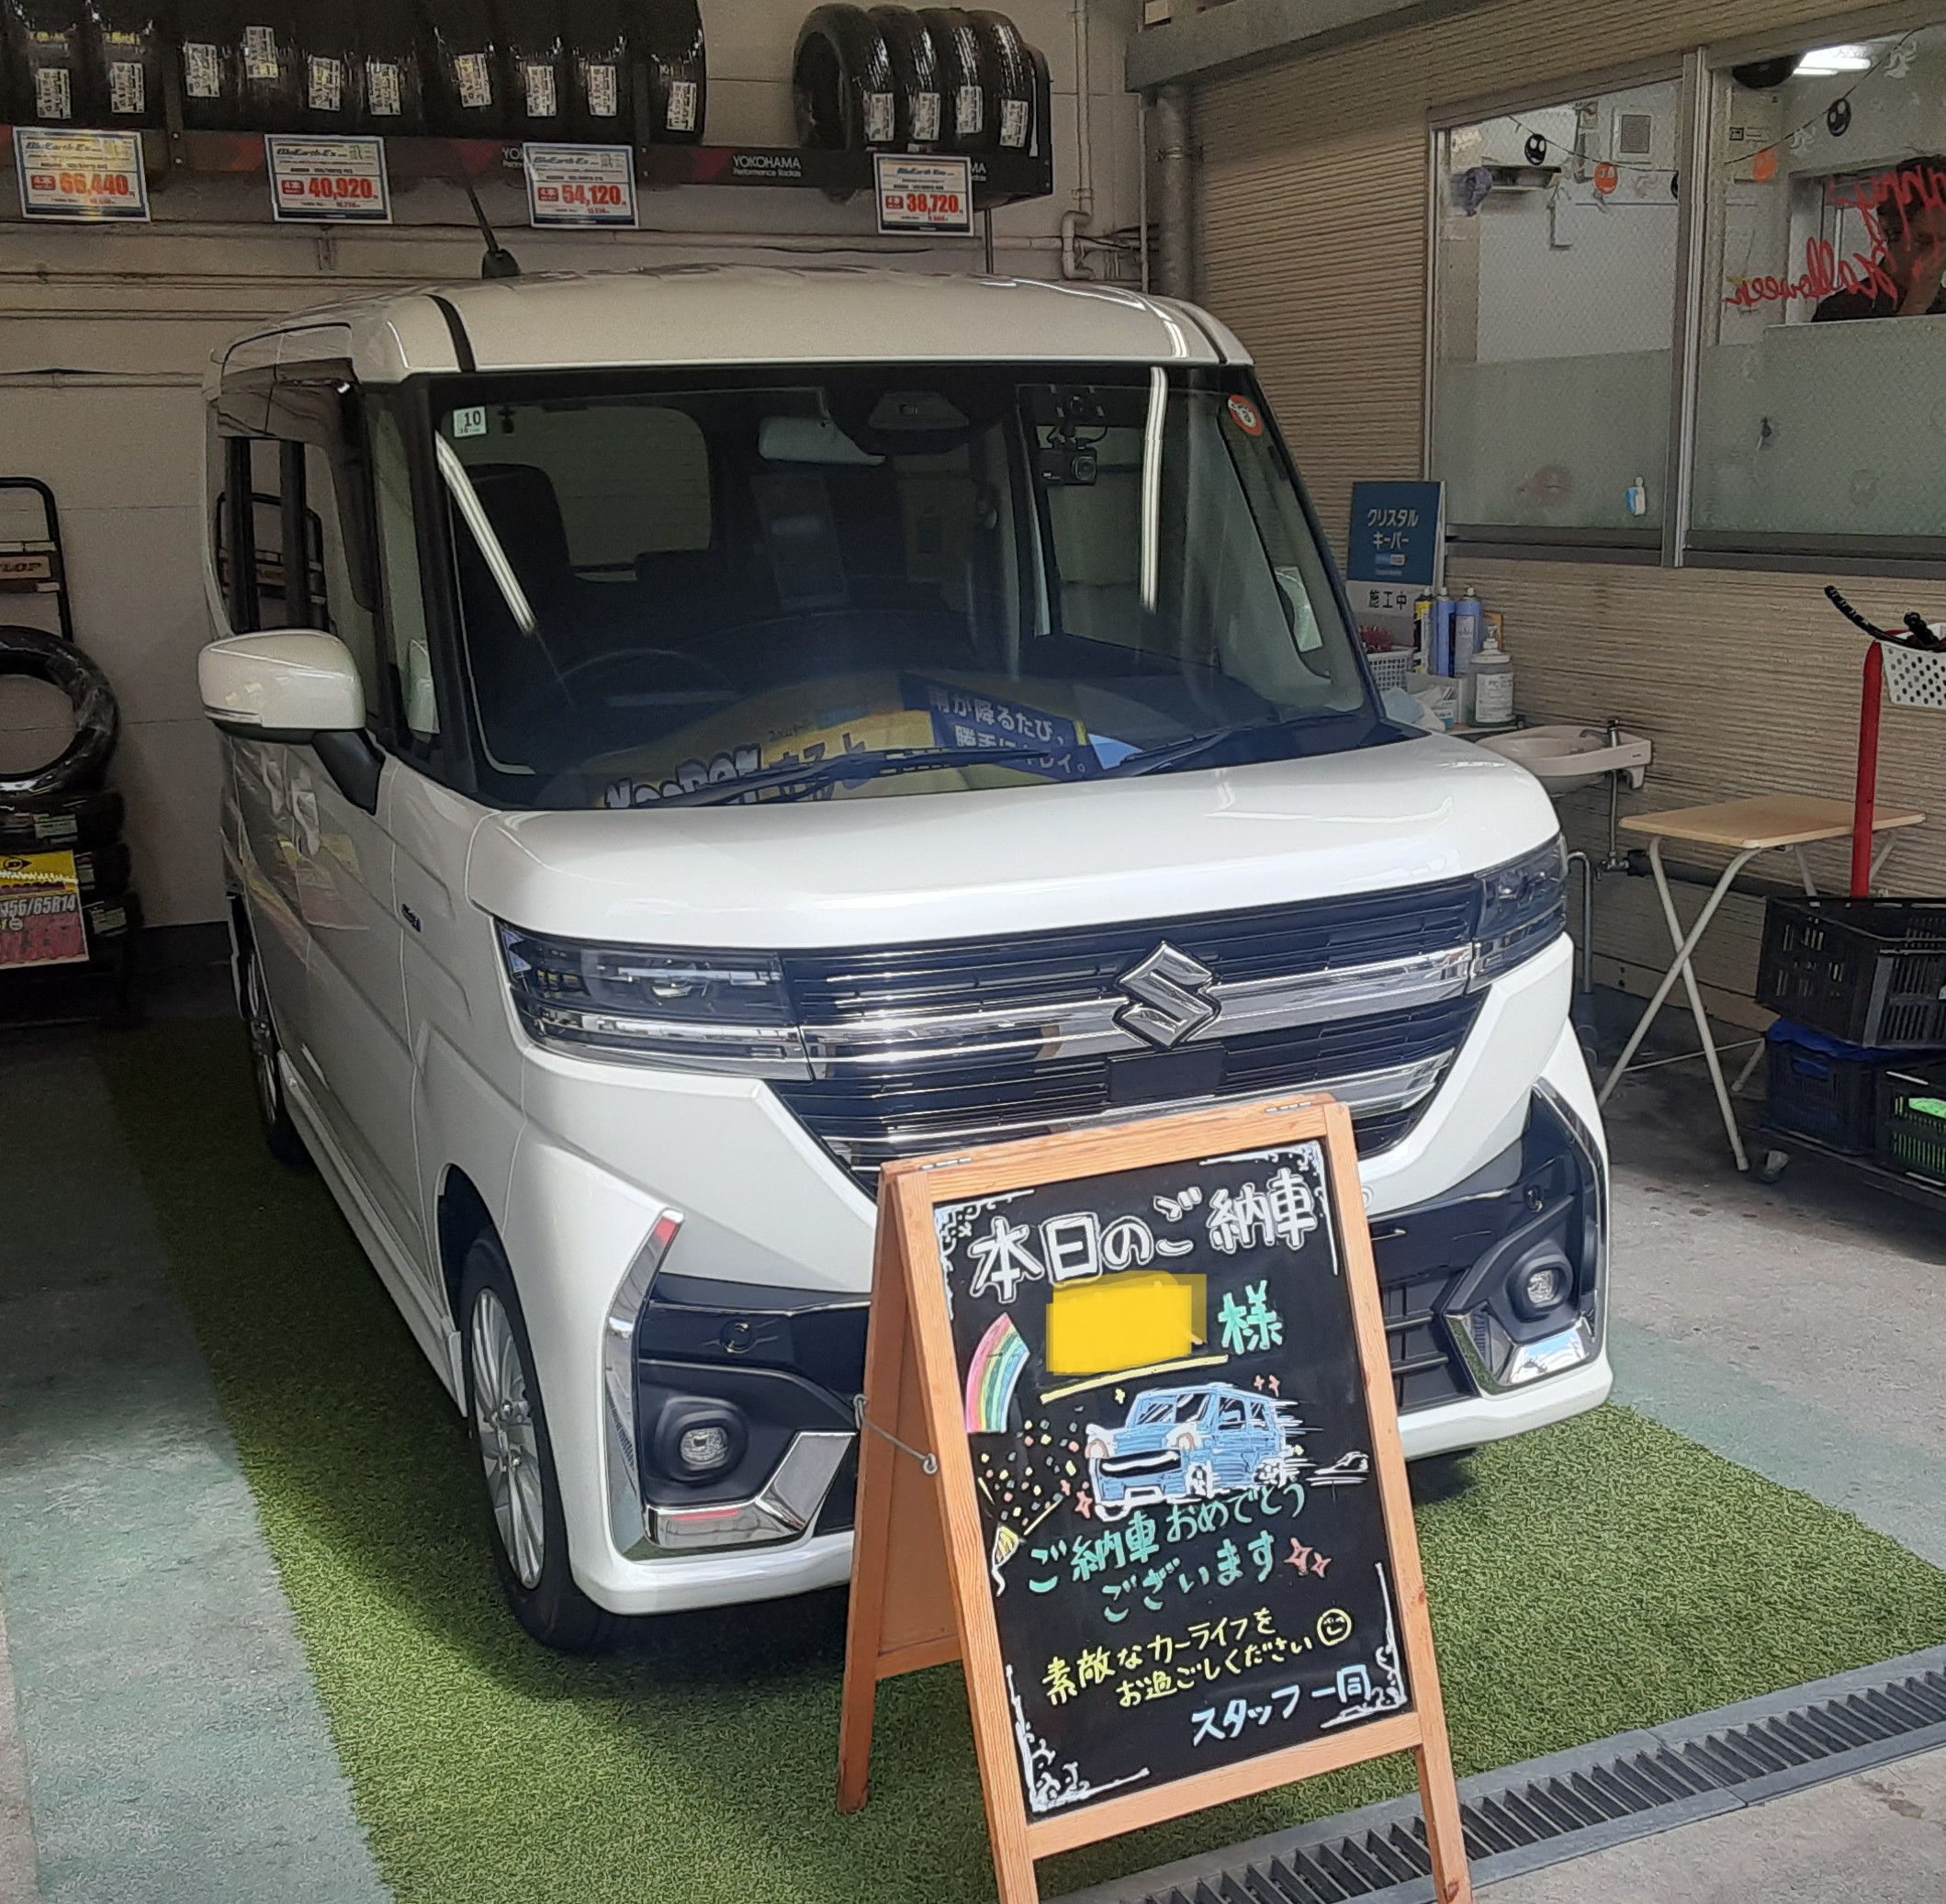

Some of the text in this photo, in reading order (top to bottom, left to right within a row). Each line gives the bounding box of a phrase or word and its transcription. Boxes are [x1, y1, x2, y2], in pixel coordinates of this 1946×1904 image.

[732, 155, 802, 169] YOKOHAMA
[59, 172, 129, 196] 66,440
[309, 177, 373, 199] 40,920
[562, 184, 622, 206] 54,120
[906, 193, 960, 215] 38,720
[464, 411, 481, 427] 10
[1367, 508, 1420, 528] クリスタル
[1373, 532, 1410, 550] キーパー
[1368, 589, 1407, 611] 施工中
[967, 1167, 1318, 1303] 本日のご納車
[1218, 1279, 1283, 1355] 様
[1102, 1529, 1275, 1623] ございます
[1041, 1606, 1276, 1706] 素敵なカーライフを
[1115, 1636, 1313, 1707] お過ごしください
[1191, 1663, 1372, 1746] スタッフ一同
